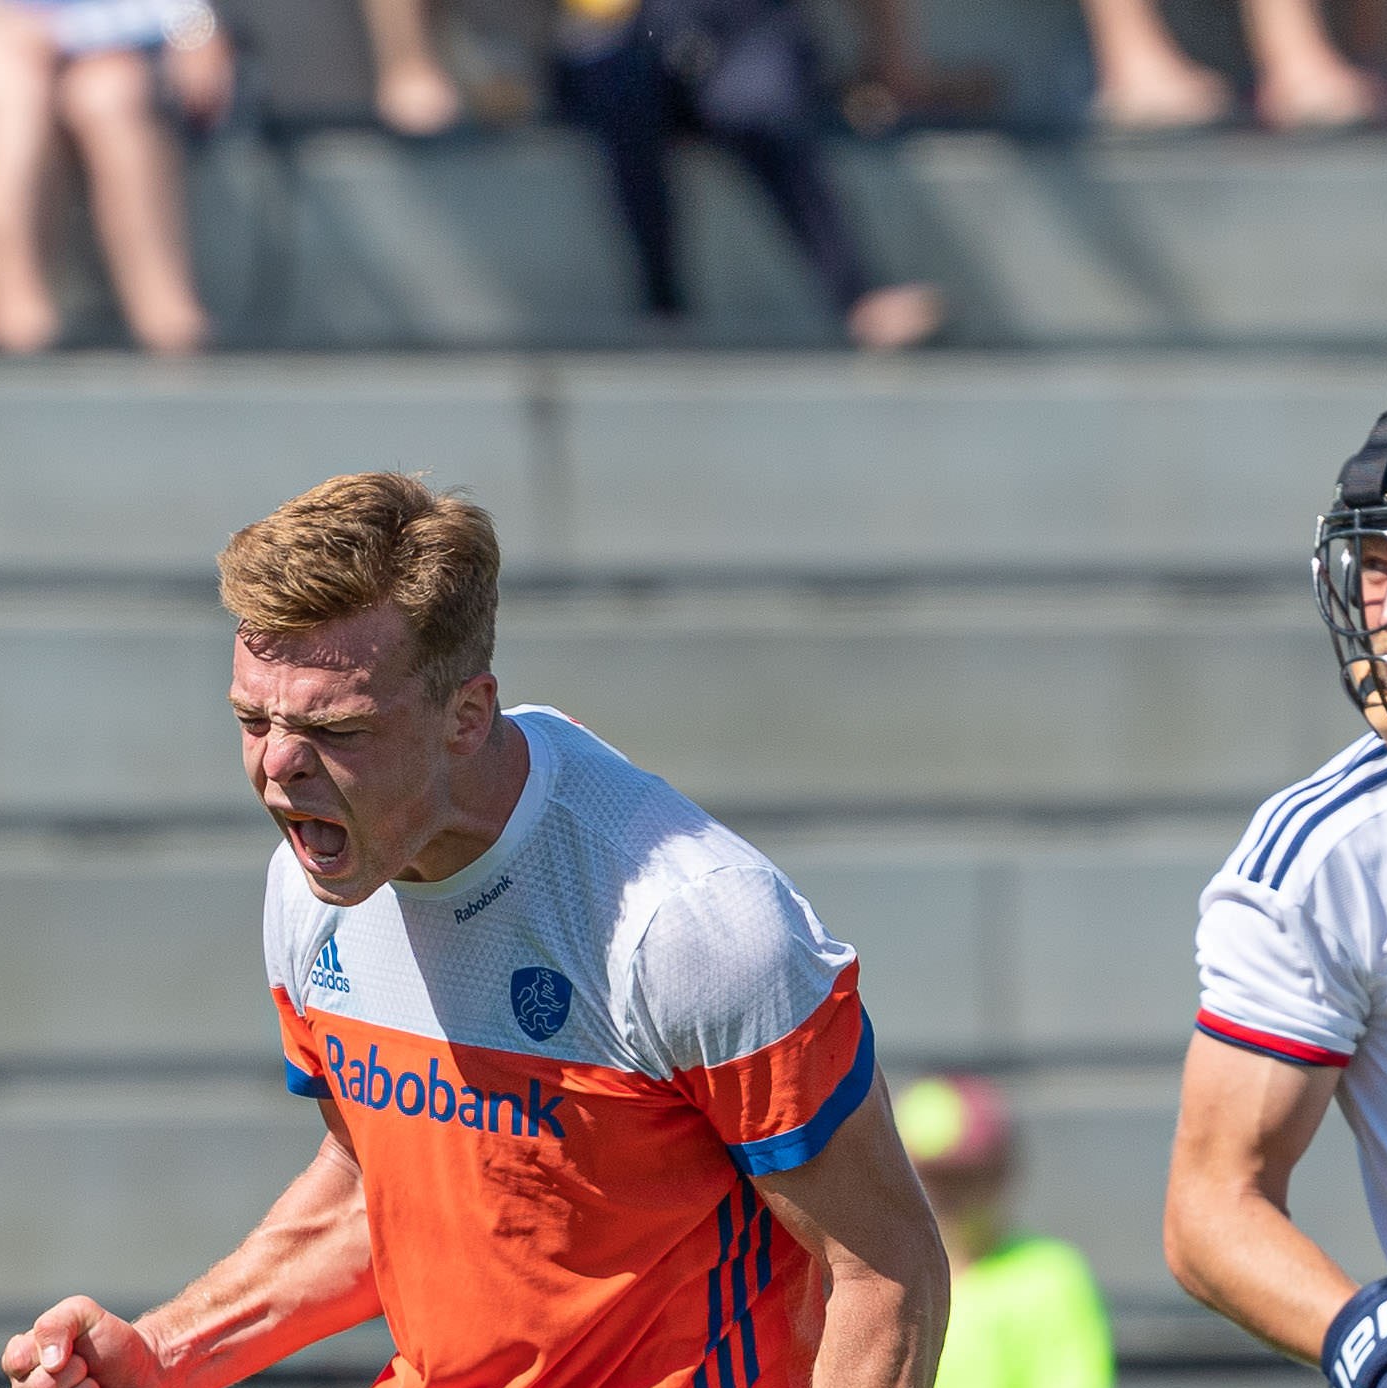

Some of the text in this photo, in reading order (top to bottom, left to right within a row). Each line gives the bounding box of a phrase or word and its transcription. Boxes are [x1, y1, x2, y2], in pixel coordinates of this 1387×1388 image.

[454, 875, 513, 925] Rabobank
[311, 969, 351, 993] adidas
[325, 1034, 566, 1139] Rabobank
